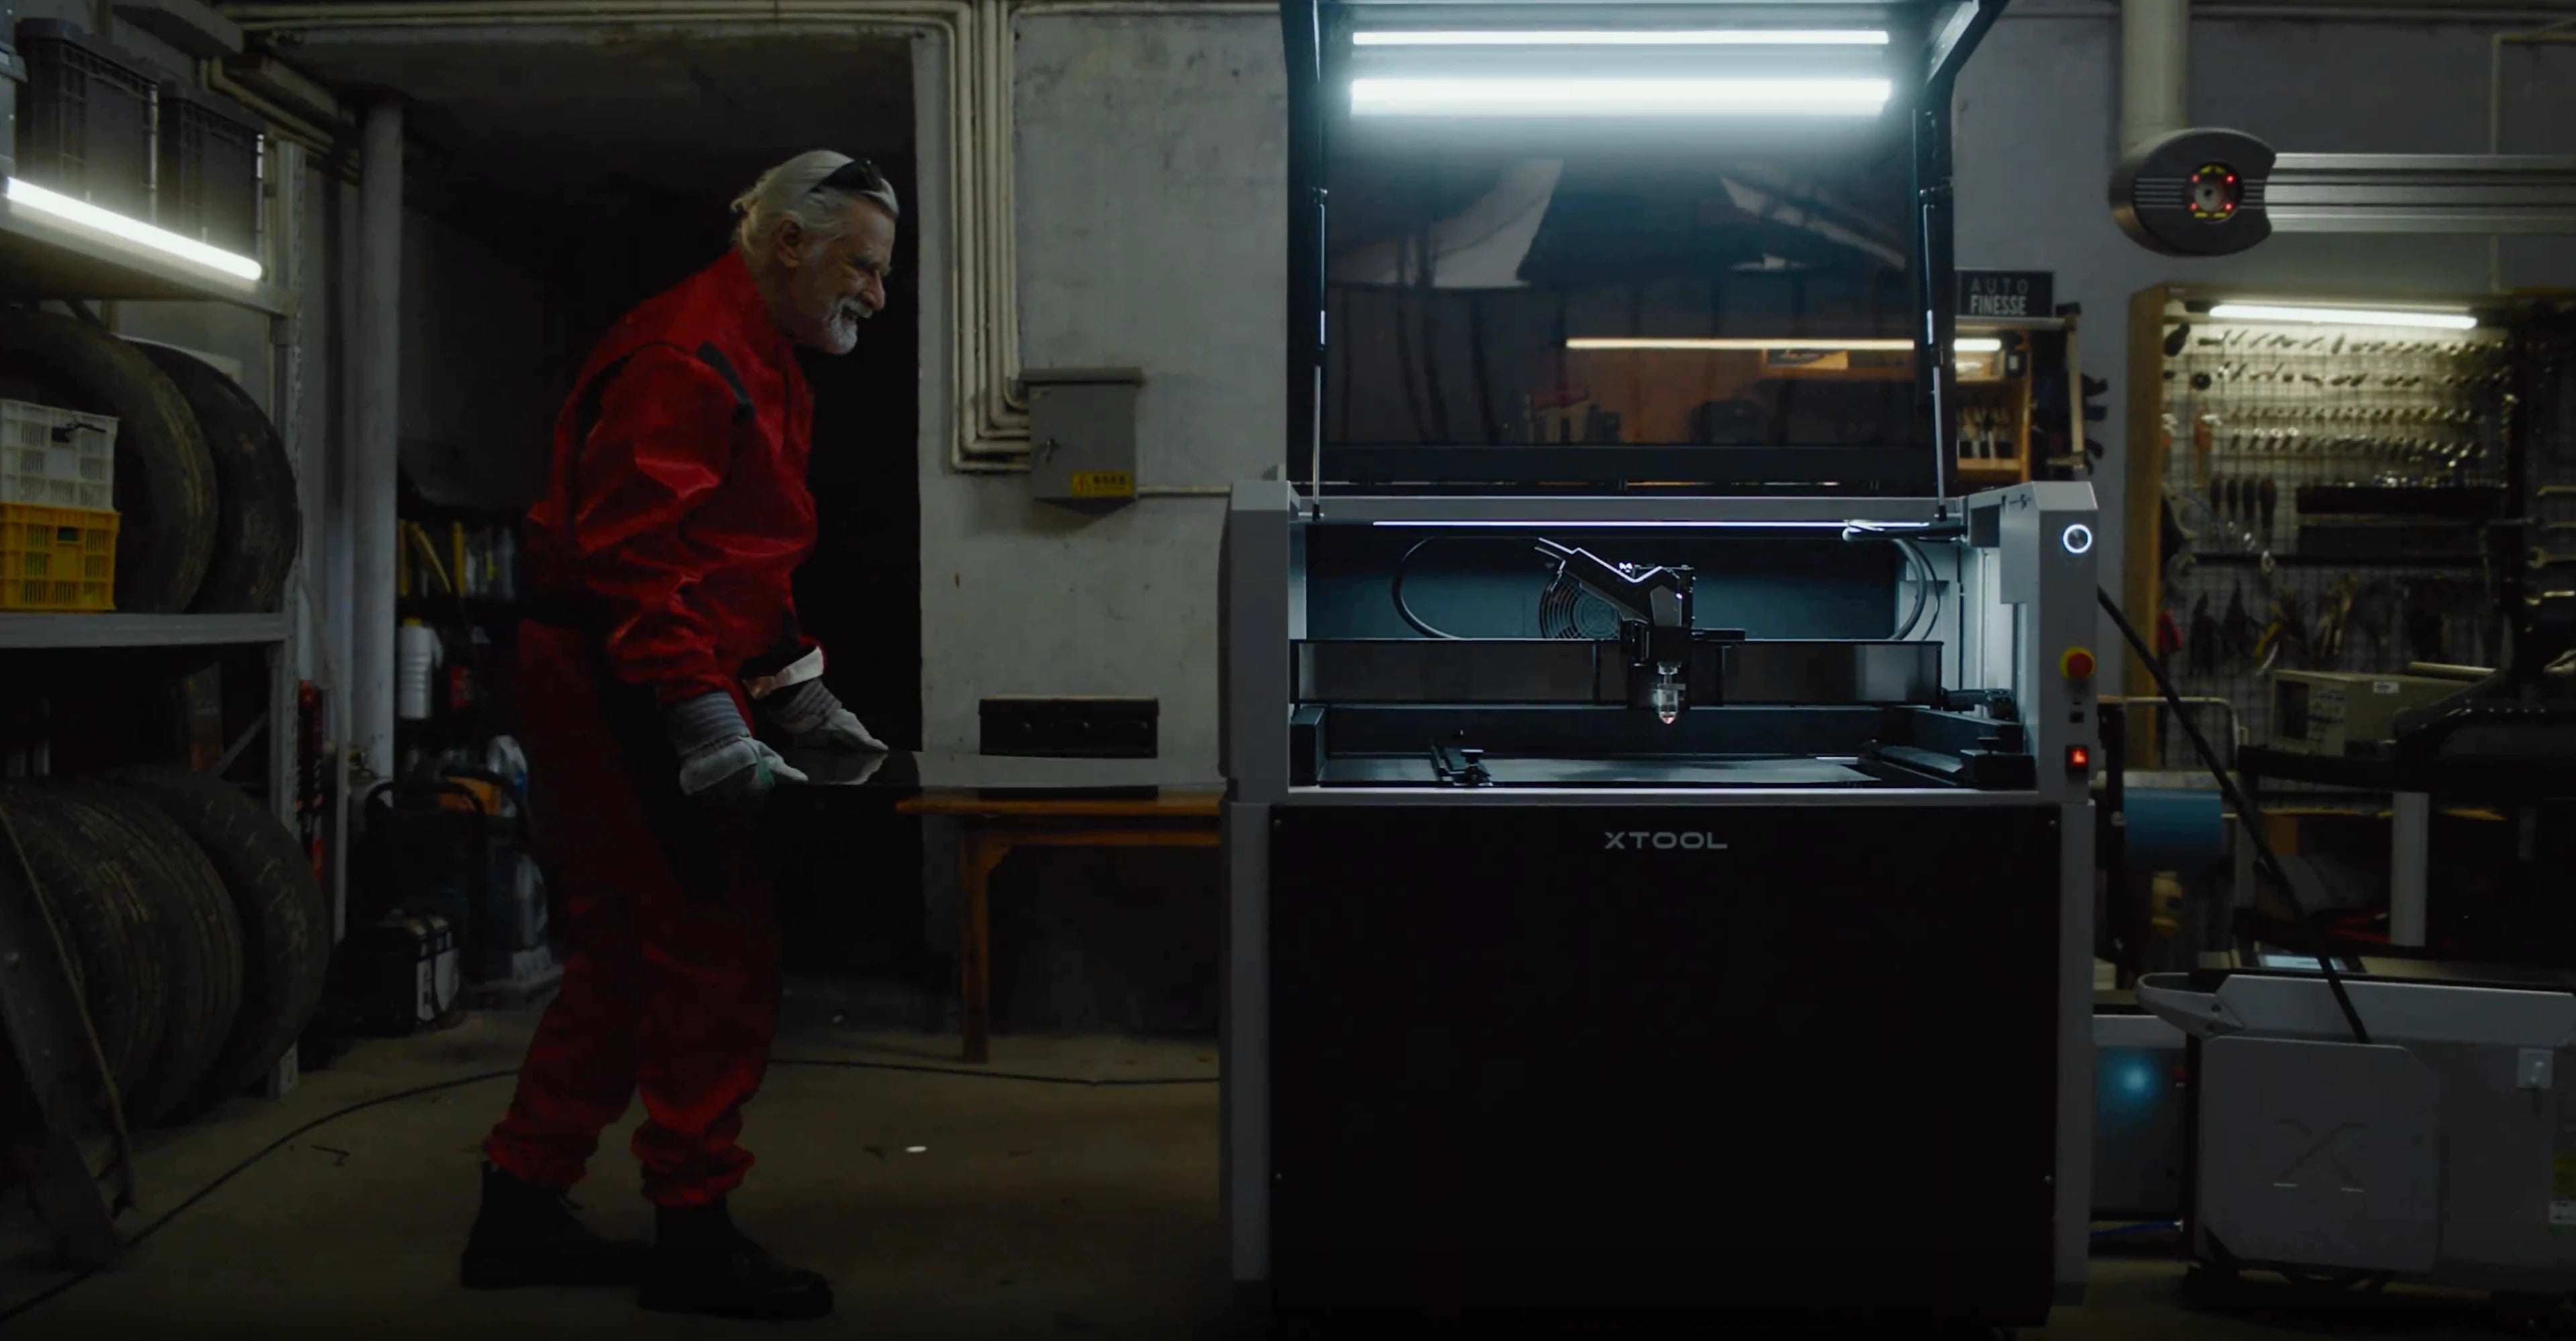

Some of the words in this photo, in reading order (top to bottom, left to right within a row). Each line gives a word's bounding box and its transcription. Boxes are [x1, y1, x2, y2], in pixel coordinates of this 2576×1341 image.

[1970, 278, 2029, 295] AUTO
[1970, 294, 2028, 315] FINESSE
[1604, 831, 1729, 850] XTOOL
